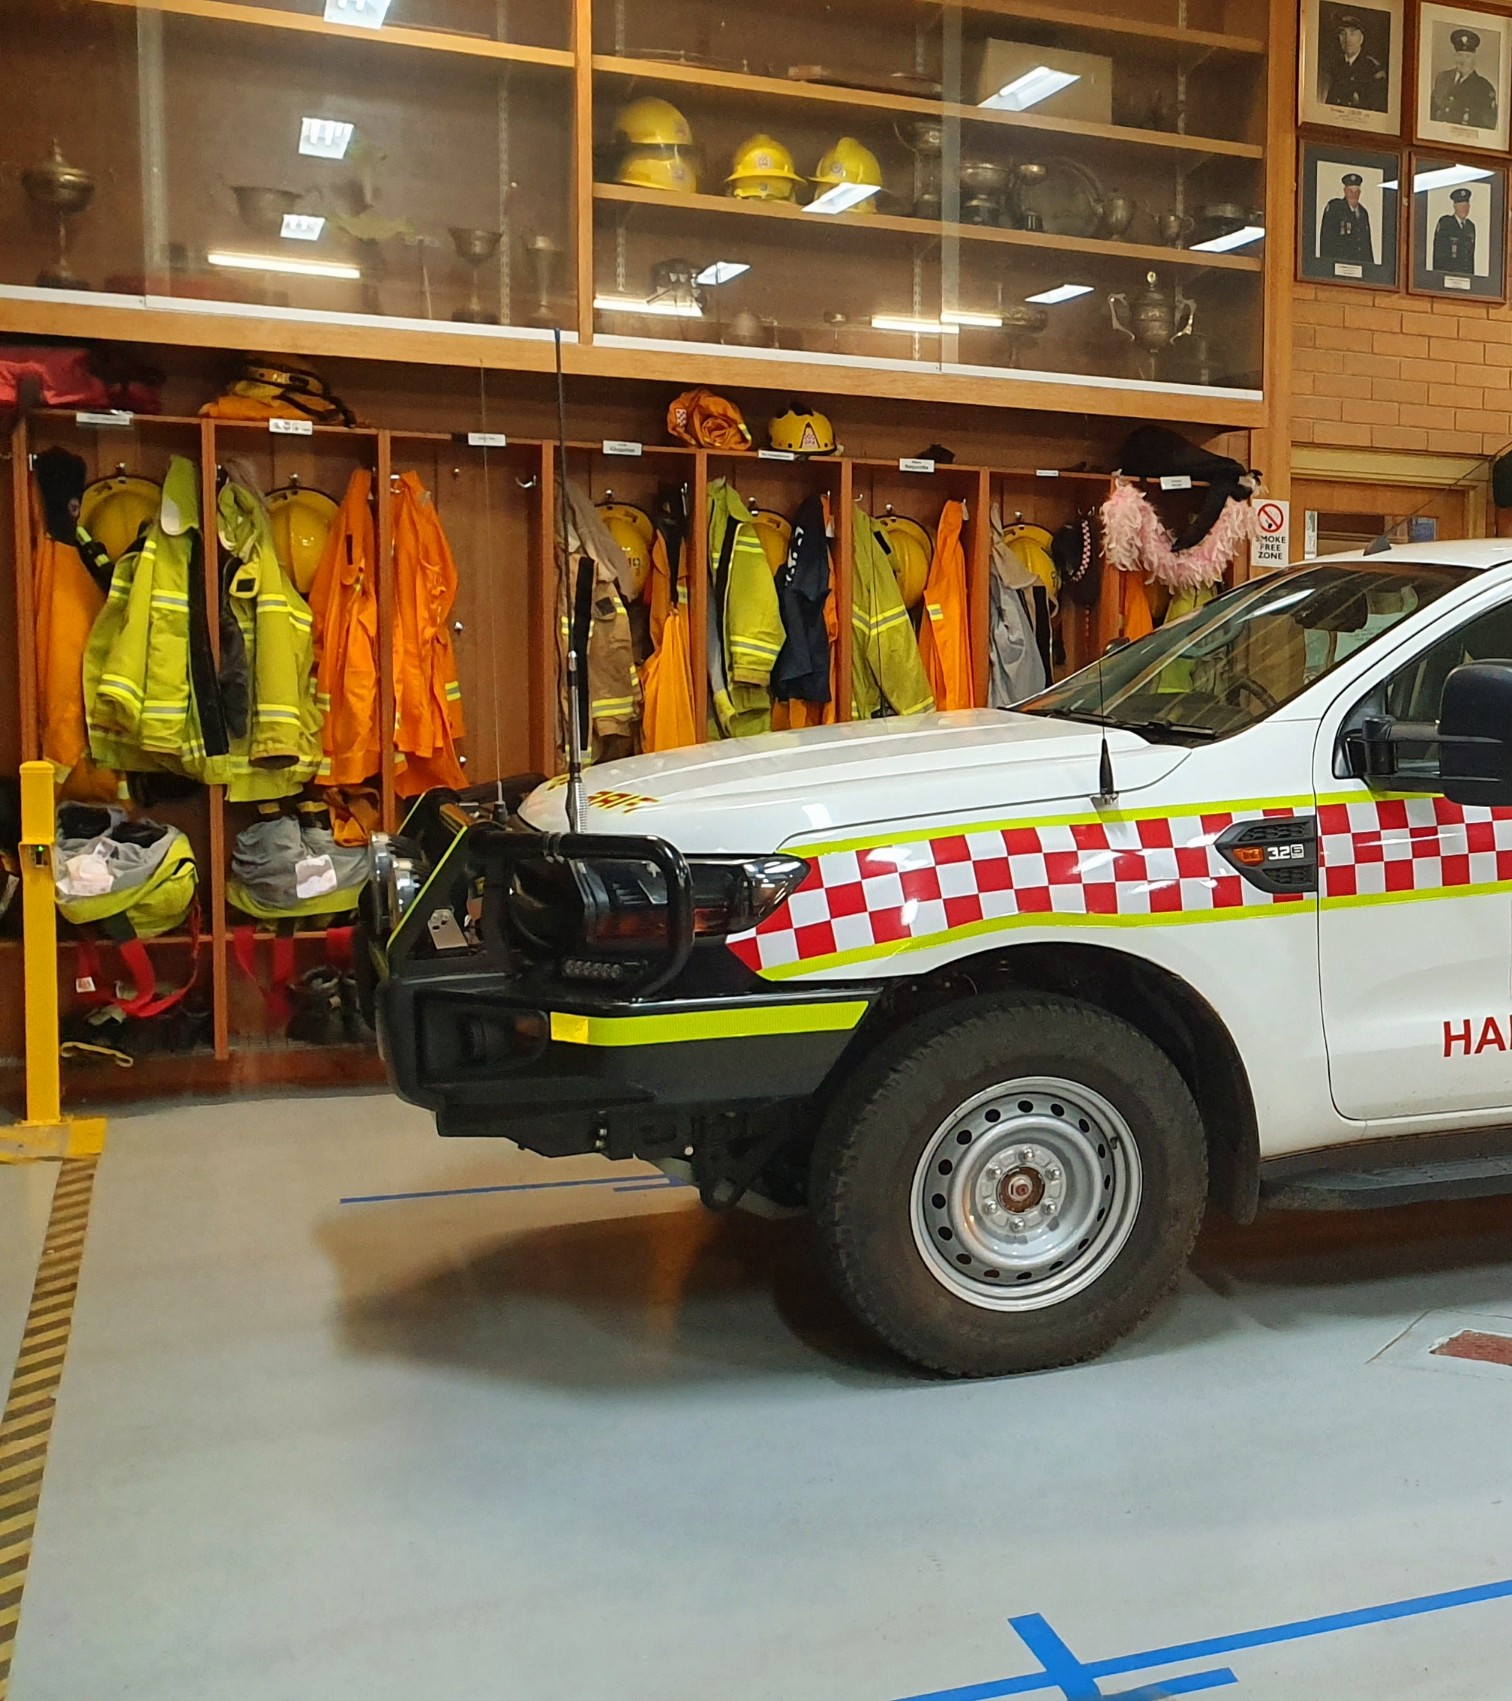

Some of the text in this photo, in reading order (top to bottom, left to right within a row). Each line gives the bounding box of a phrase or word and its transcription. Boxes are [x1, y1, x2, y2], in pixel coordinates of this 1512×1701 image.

[1255, 535, 1286, 544] SMOKE
[1260, 543, 1282, 551] FREE
[1258, 551, 1283, 560] ZONE
